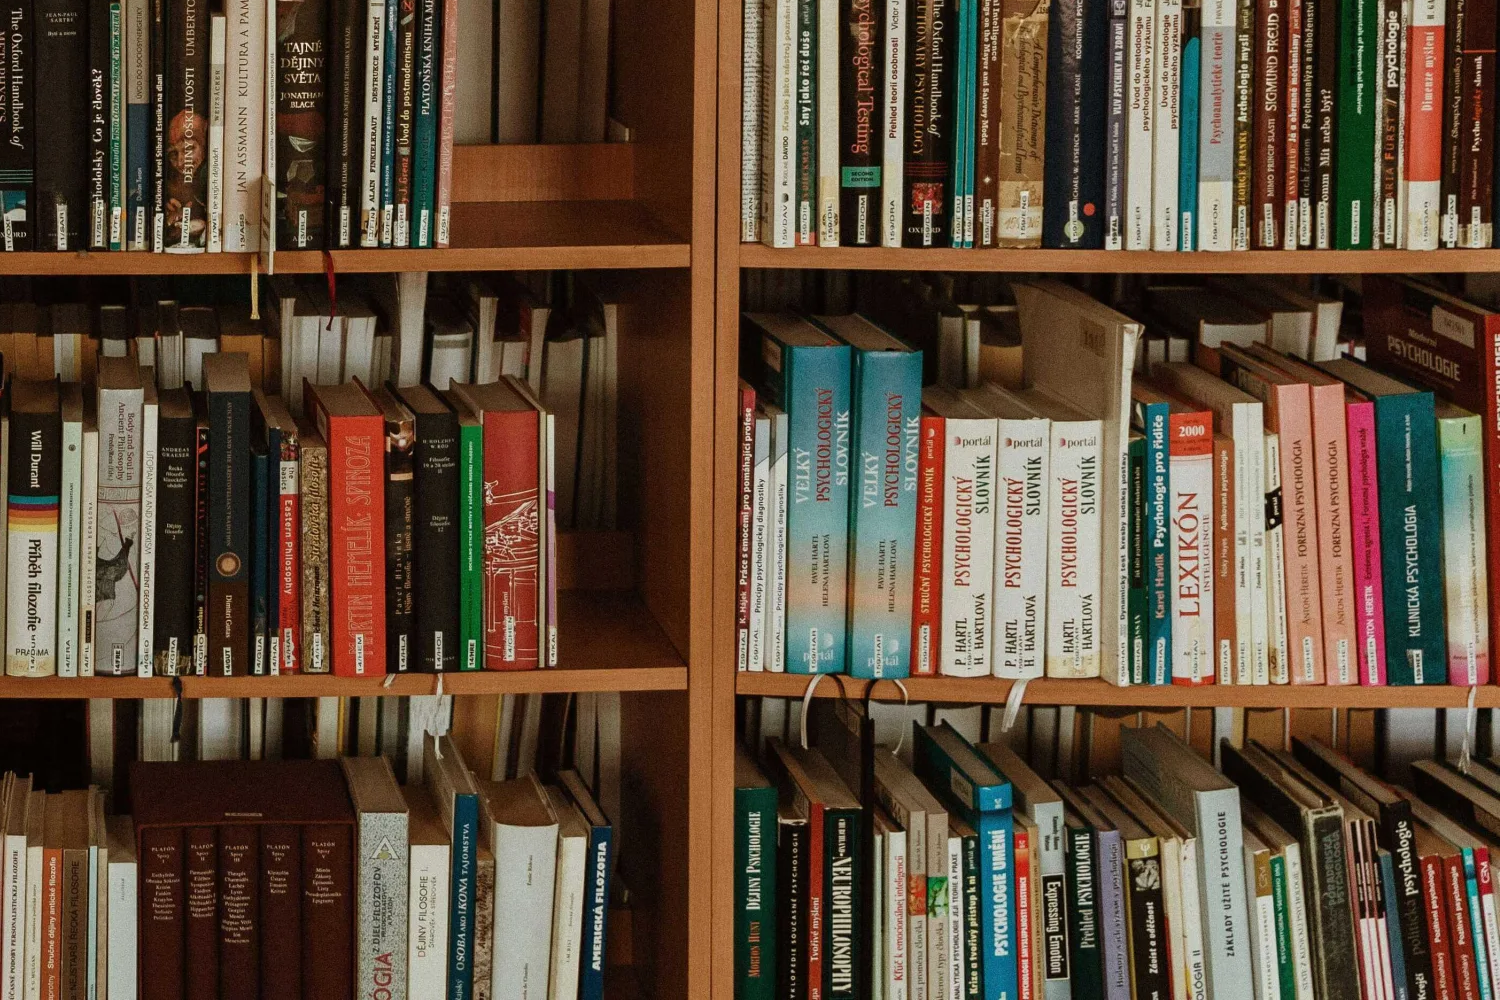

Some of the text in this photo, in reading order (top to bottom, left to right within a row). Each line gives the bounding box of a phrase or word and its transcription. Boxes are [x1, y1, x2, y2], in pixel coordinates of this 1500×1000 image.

[284, 73, 321, 83] SVĚTA
[1266, 13, 1279, 112] SIGMUND FREUD
[1385, 11, 1400, 88] psychologie
[851, 96, 874, 154] Testing
[30, 430, 42, 488] Will Durant
[1179, 425, 1205, 437] 2000
[975, 455, 990, 514] SLOVNÍK
[28, 539, 41, 577] Příběh
[283, 500, 292, 594] Eastern Philosophy
[953, 476, 973, 587] PSYCHOLOGICKÝ
[1173, 492, 1200, 618] LEXIKÓN
[1395, 821, 1419, 896] psychologie
[591, 841, 608, 971] AMERICKÁ FILOZOFIA
[830, 856, 852, 993] NEUROPHILOSOPHY
[991, 872, 1008, 956] PSYCHOLOGIE
[1045, 881, 1064, 974] Expressing Emotion
